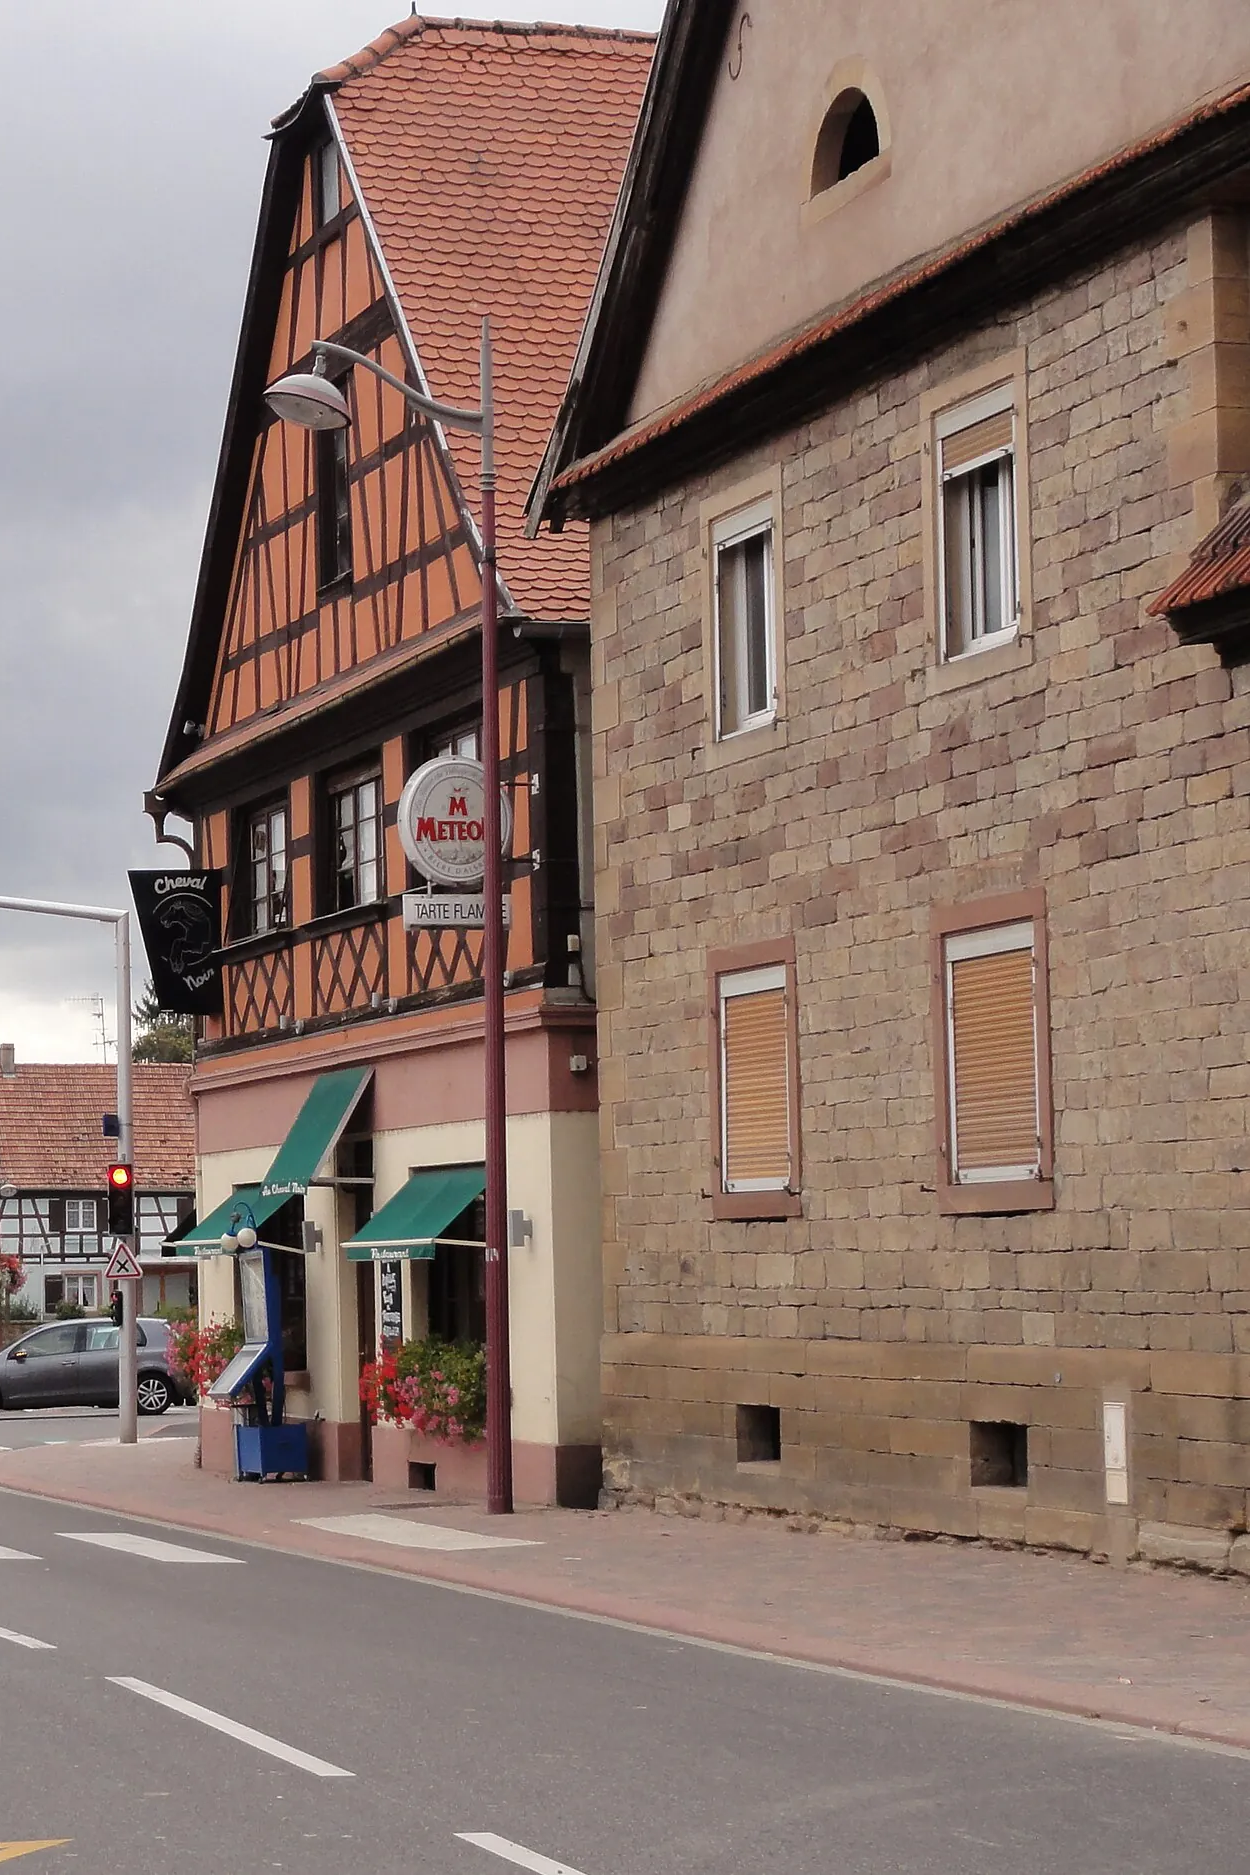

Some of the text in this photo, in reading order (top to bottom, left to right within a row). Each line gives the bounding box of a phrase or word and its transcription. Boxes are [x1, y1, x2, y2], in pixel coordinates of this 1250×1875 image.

[448, 796, 468, 816] M
[154, 876, 207, 894] Cheval
[414, 903, 507, 919] TARTE FLAME
